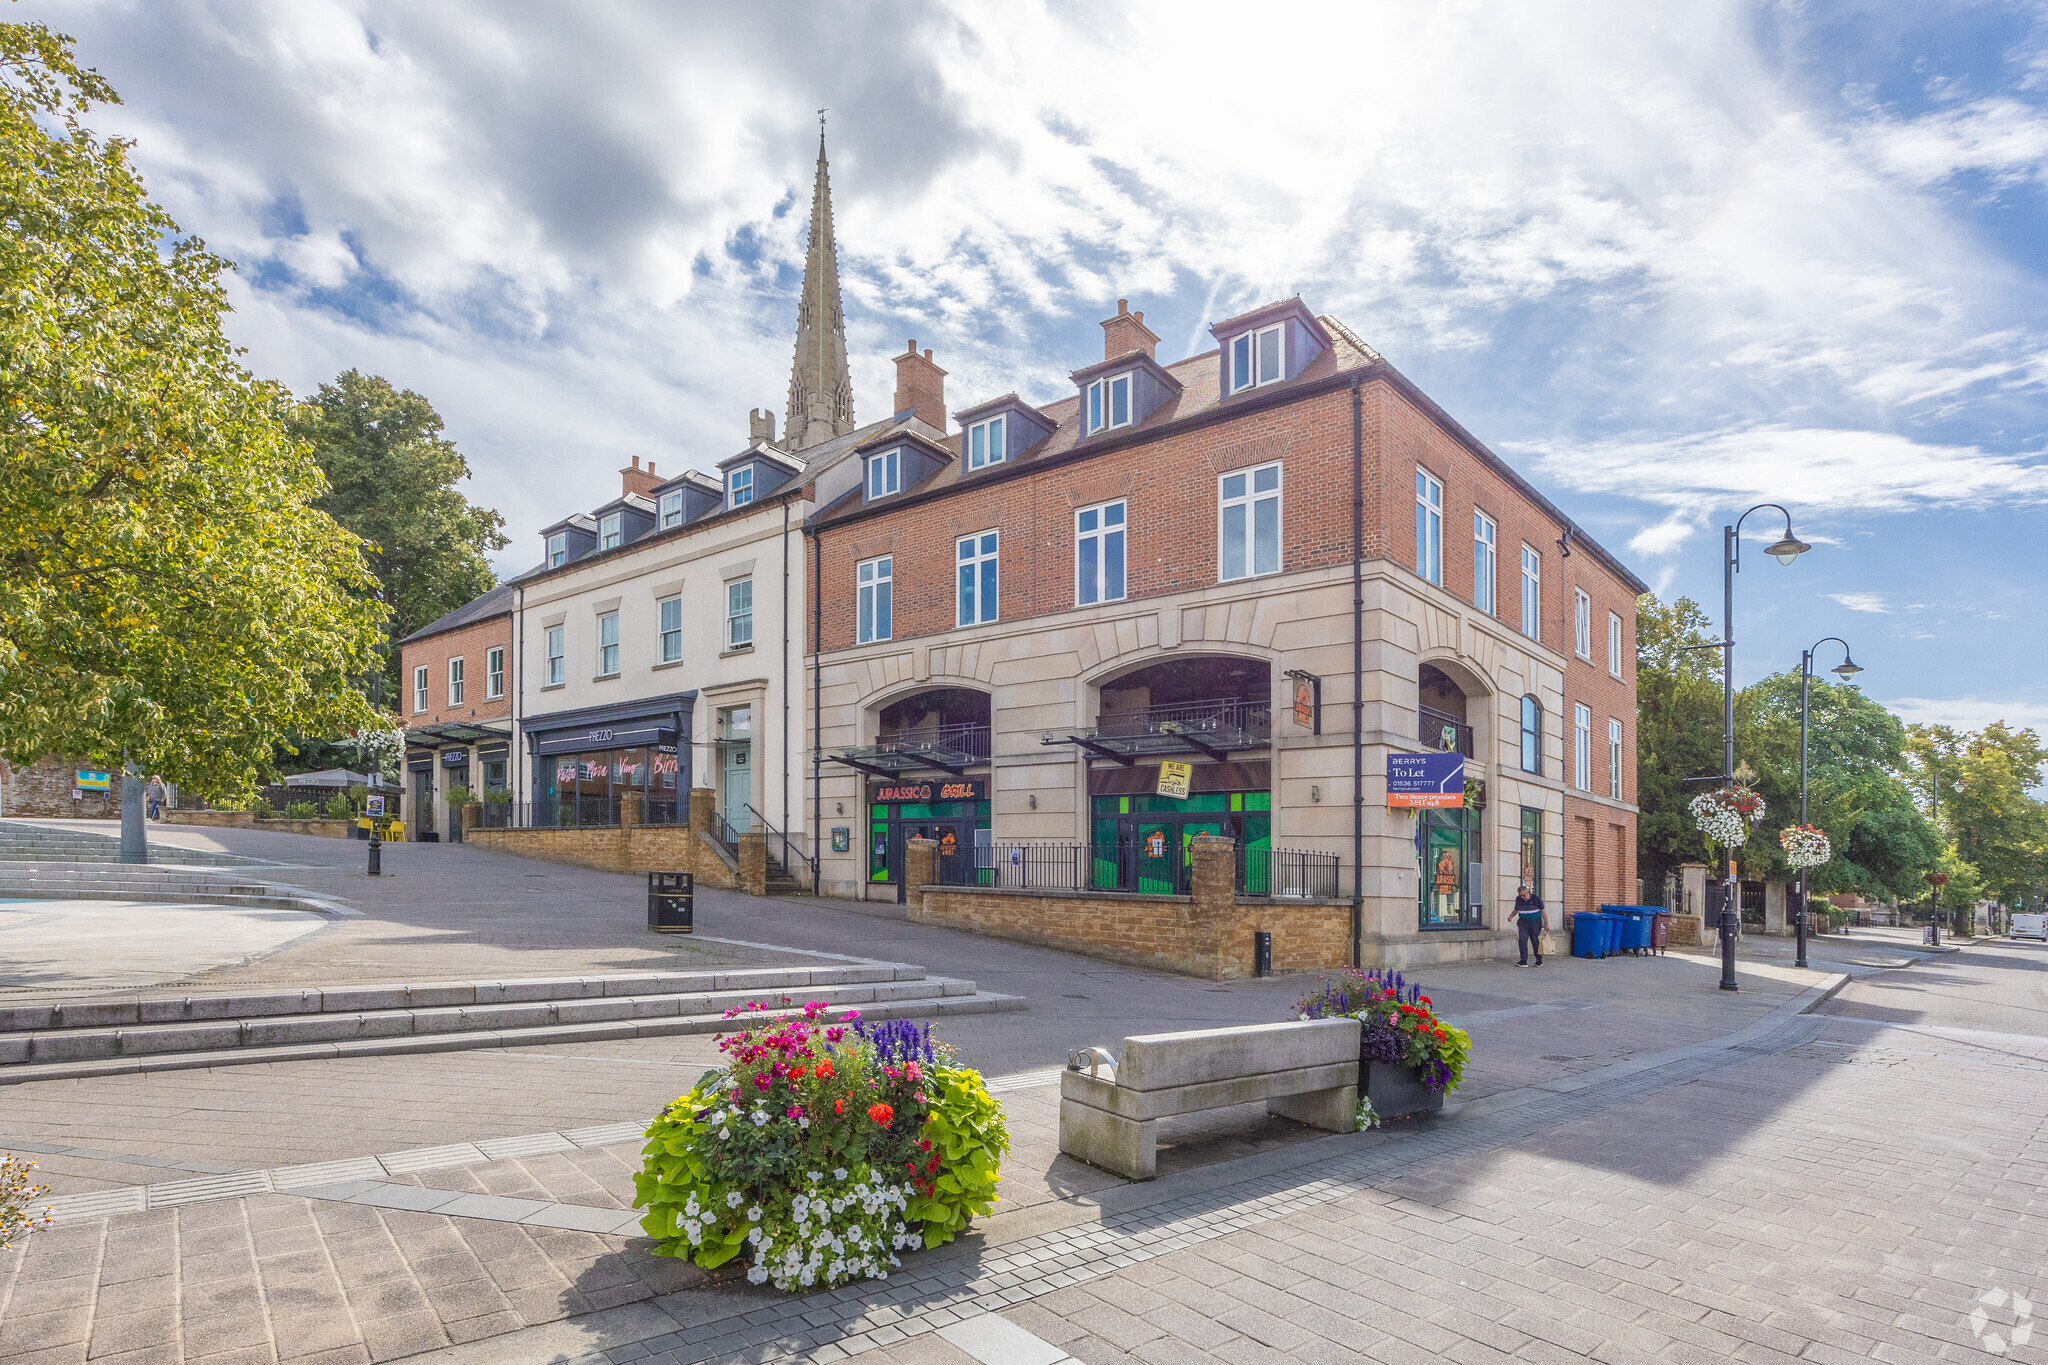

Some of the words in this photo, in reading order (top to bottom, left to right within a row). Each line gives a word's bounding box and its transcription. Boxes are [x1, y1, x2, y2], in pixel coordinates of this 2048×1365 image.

[590, 729, 613, 743] PREZZO
[658, 744, 678, 753] PREZZO
[445, 751, 463, 762] PREZZO
[619, 756, 642, 776] Vino
[1176, 764, 1185, 772] ARE
[1392, 768, 1407, 777] To
[1408, 768, 1425, 777] Let
[877, 786, 920, 800] JURASSIC
[941, 783, 975, 799] GRILL
[1160, 784, 1186, 796] CASHLESS
